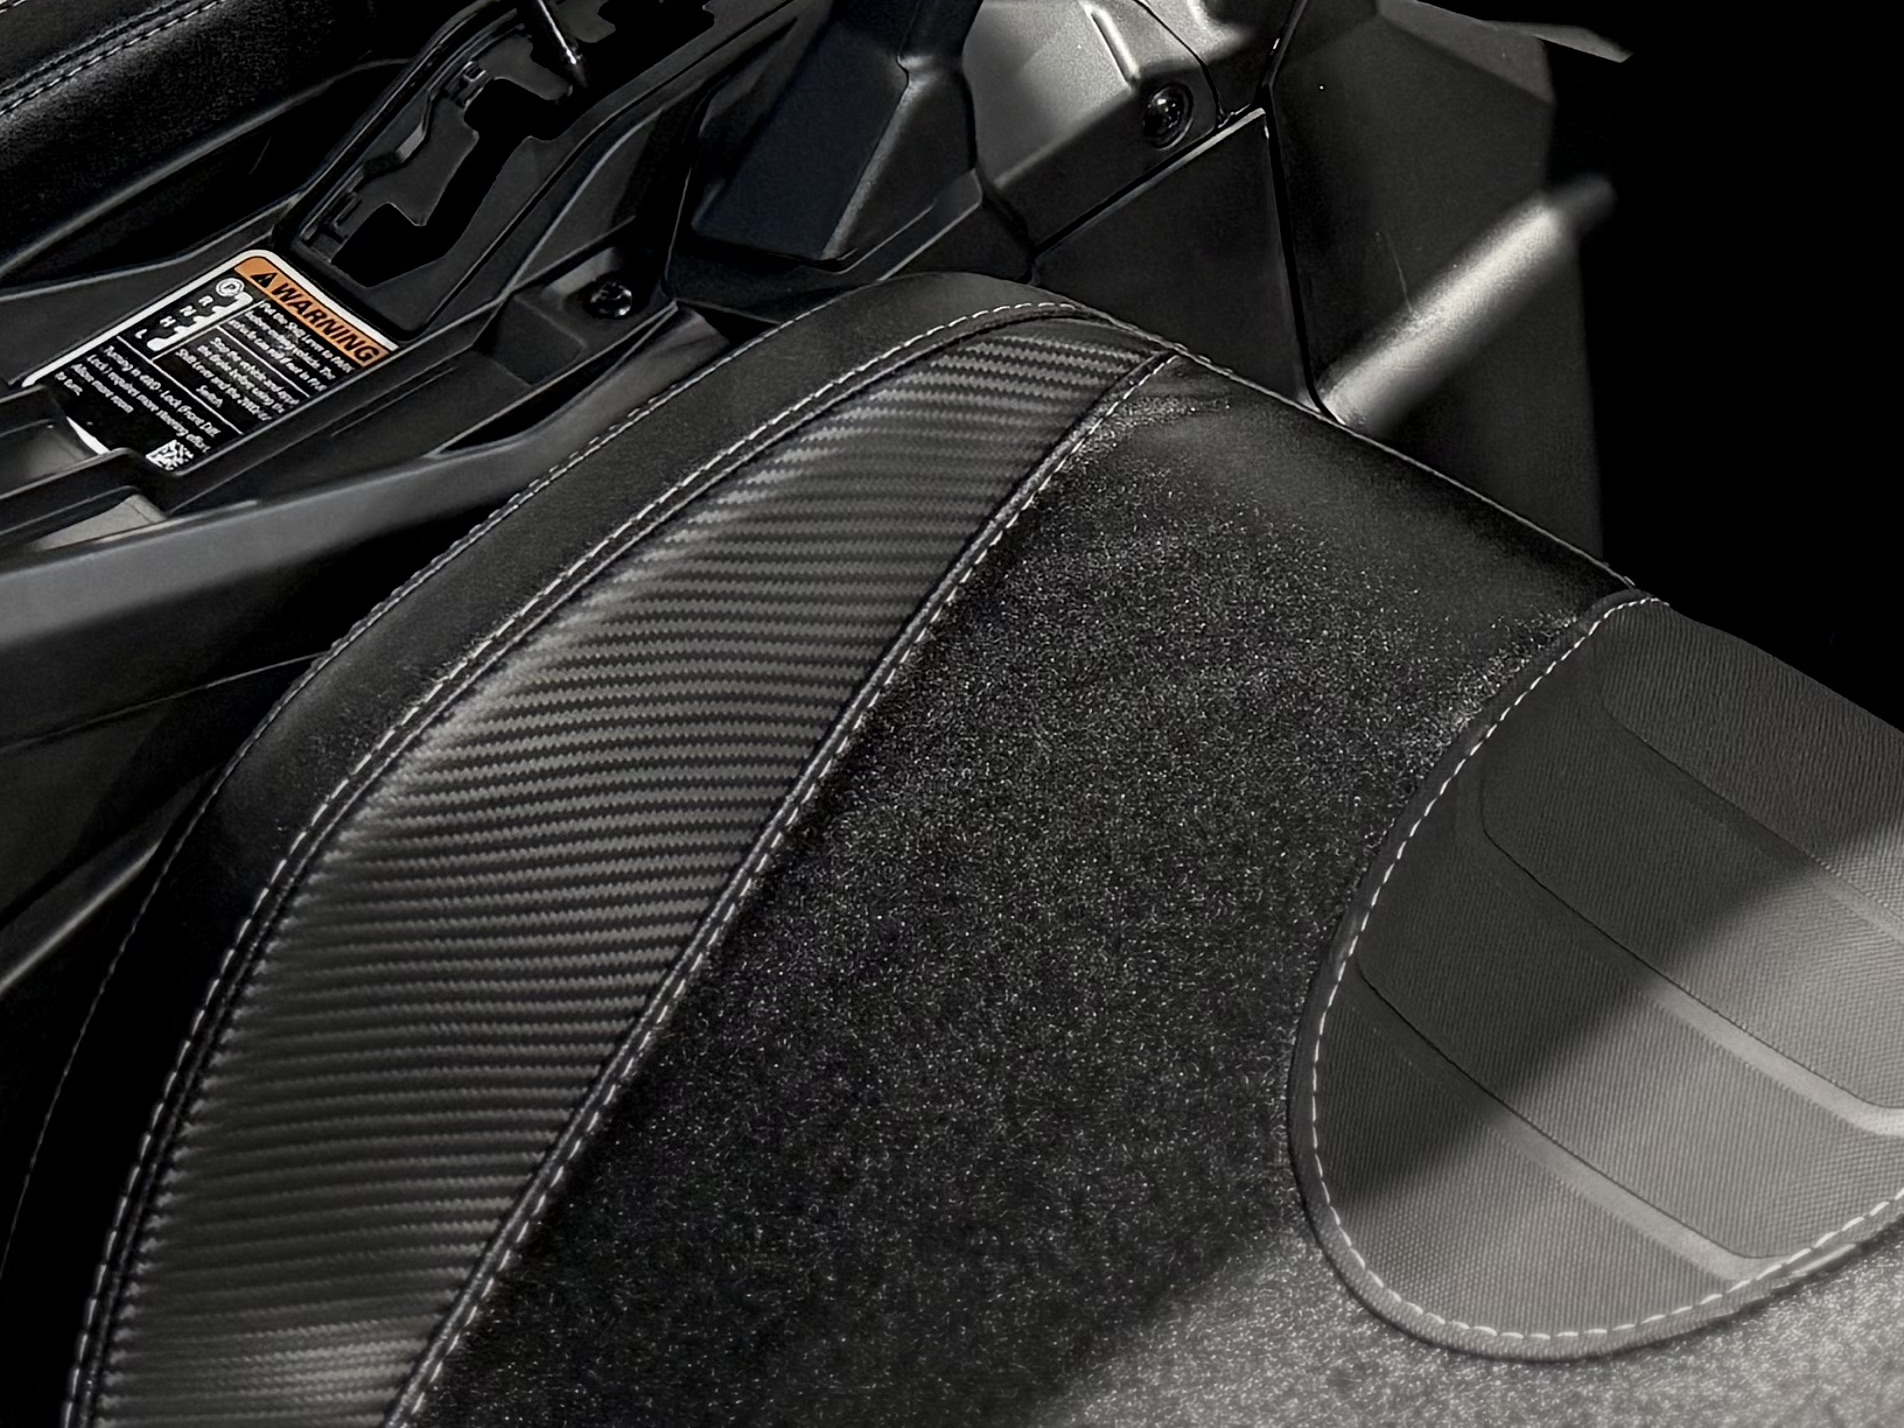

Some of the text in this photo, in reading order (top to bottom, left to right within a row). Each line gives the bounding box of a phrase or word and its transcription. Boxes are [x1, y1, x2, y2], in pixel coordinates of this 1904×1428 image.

[197, 294, 214, 307] R
[178, 304, 197, 317] N
[159, 315, 176, 327] H
[270, 281, 380, 363] WARNING
[134, 328, 147, 339] L
[159, 389, 182, 408] Lock
